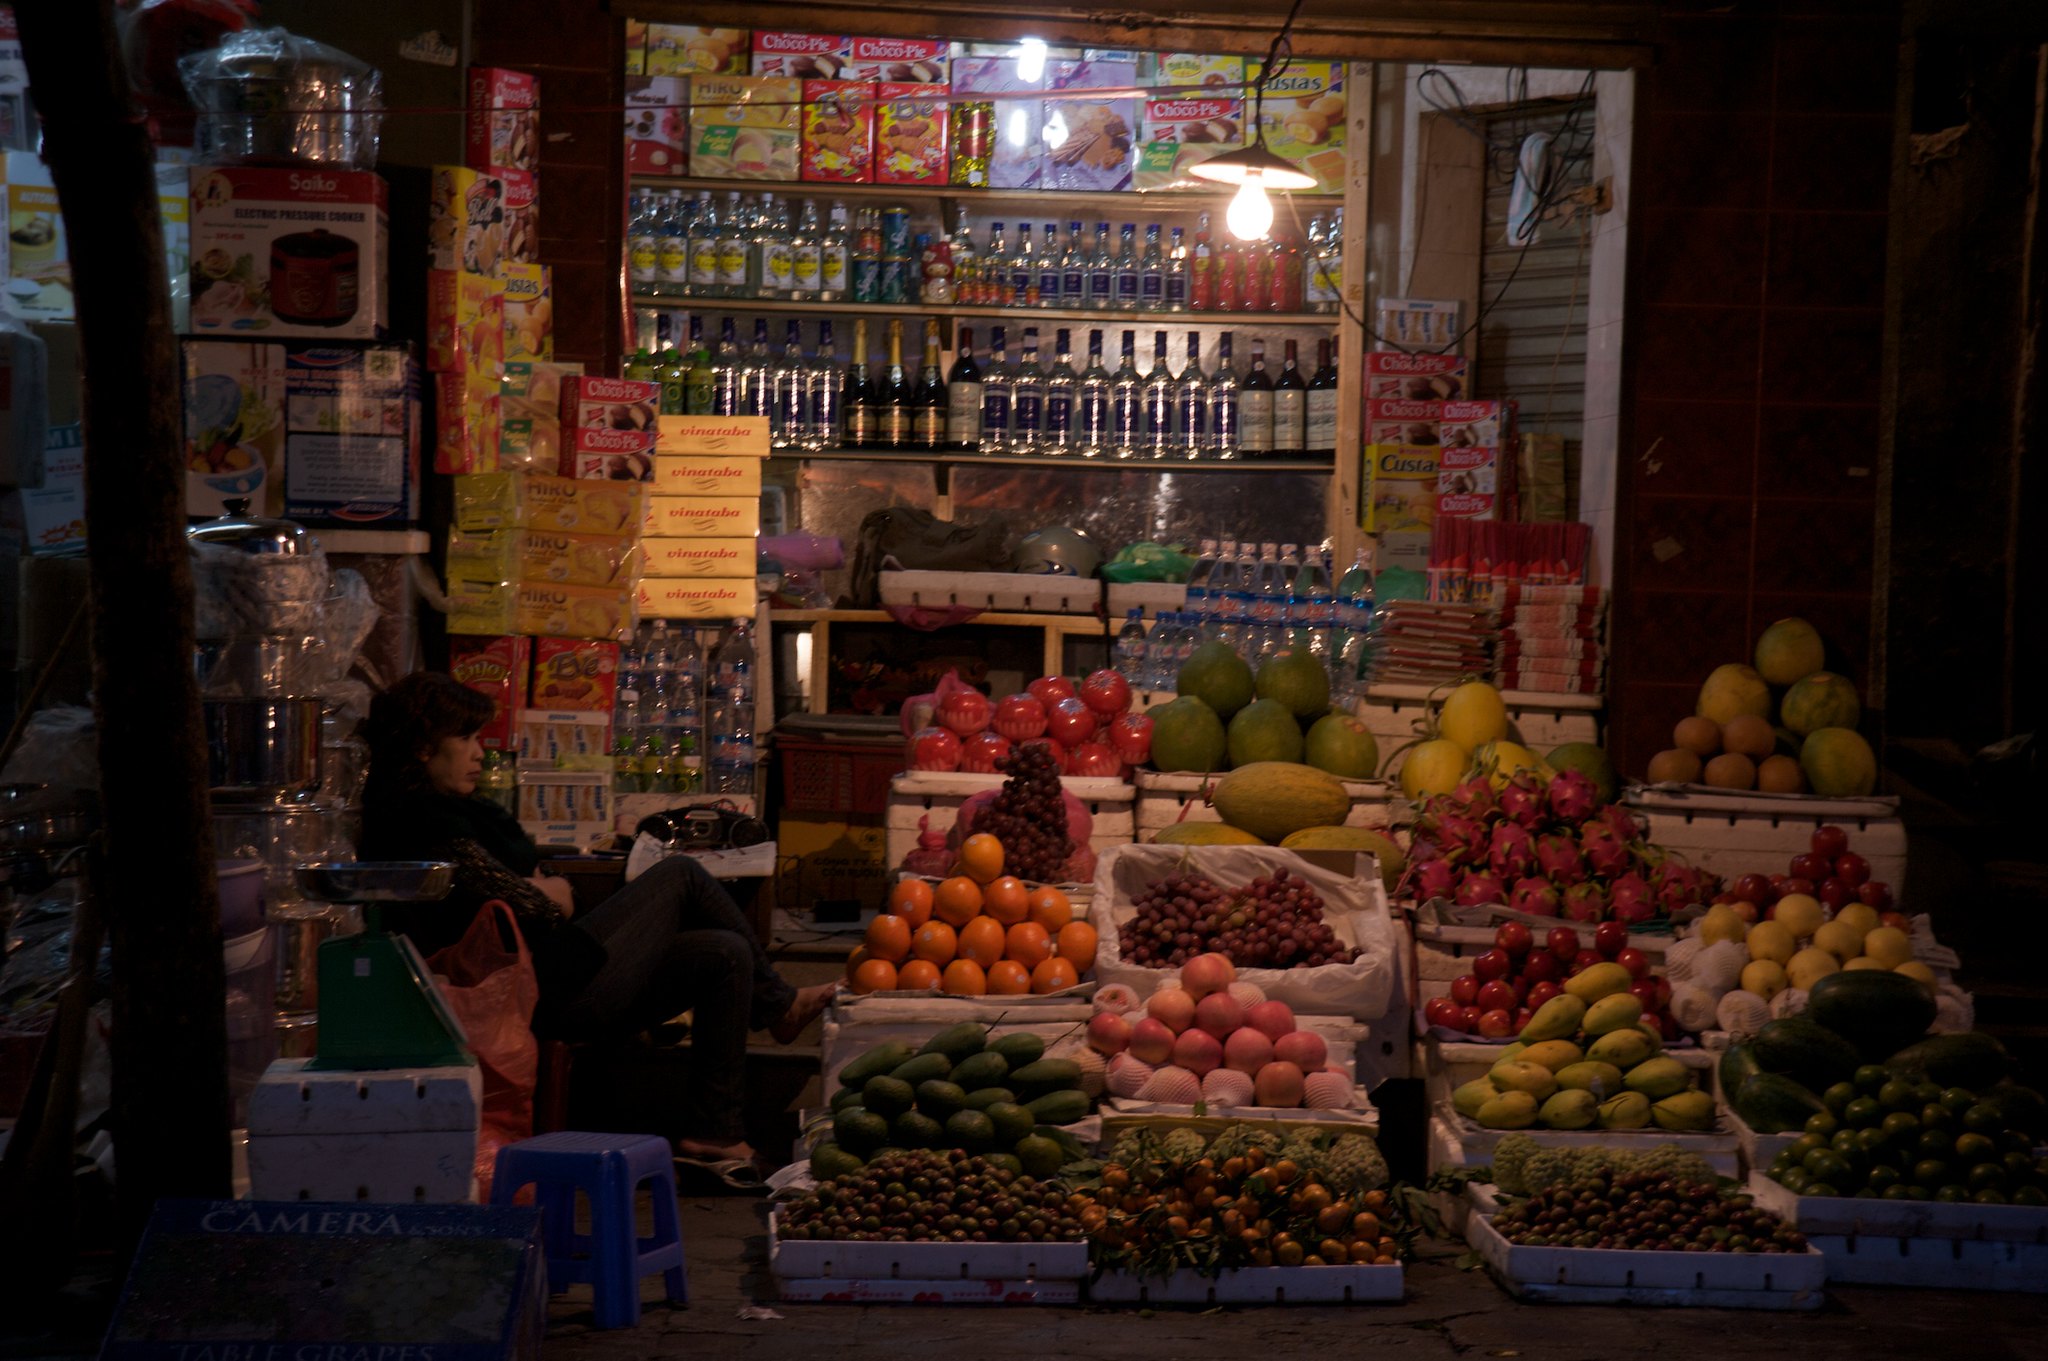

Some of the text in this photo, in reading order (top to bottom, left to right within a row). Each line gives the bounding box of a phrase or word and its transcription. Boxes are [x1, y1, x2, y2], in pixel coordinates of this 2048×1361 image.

[762, 34, 830, 52] Choco-Pie
[859, 42, 928, 58] Choco-Pie
[1153, 103, 1221, 118] Choco-Pie
[289, 174, 337, 191] Saiko
[235, 208, 364, 222] ELECTRIC PRESSURE COOKER
[1379, 356, 1447, 372] Choco-Pie
[587, 381, 643, 399] Choco-Pie
[1381, 402, 1440, 417] Choco-Pi
[1443, 405, 1486, 419] Choco-Pie
[680, 426, 751, 437] vinataba
[584, 432, 640, 450] Choco-Pie
[1443, 452, 1484, 465] Choco-Pie
[671, 467, 743, 477] vinataba
[1440, 497, 1486, 512] Choco-Pie
[669, 507, 741, 518] vinataba
[667, 548, 738, 559] vinataba
[666, 589, 737, 599] vinataba
[200, 1211, 403, 1234] CAMERA
[169, 1343, 436, 1361] TABLE GRAPES
